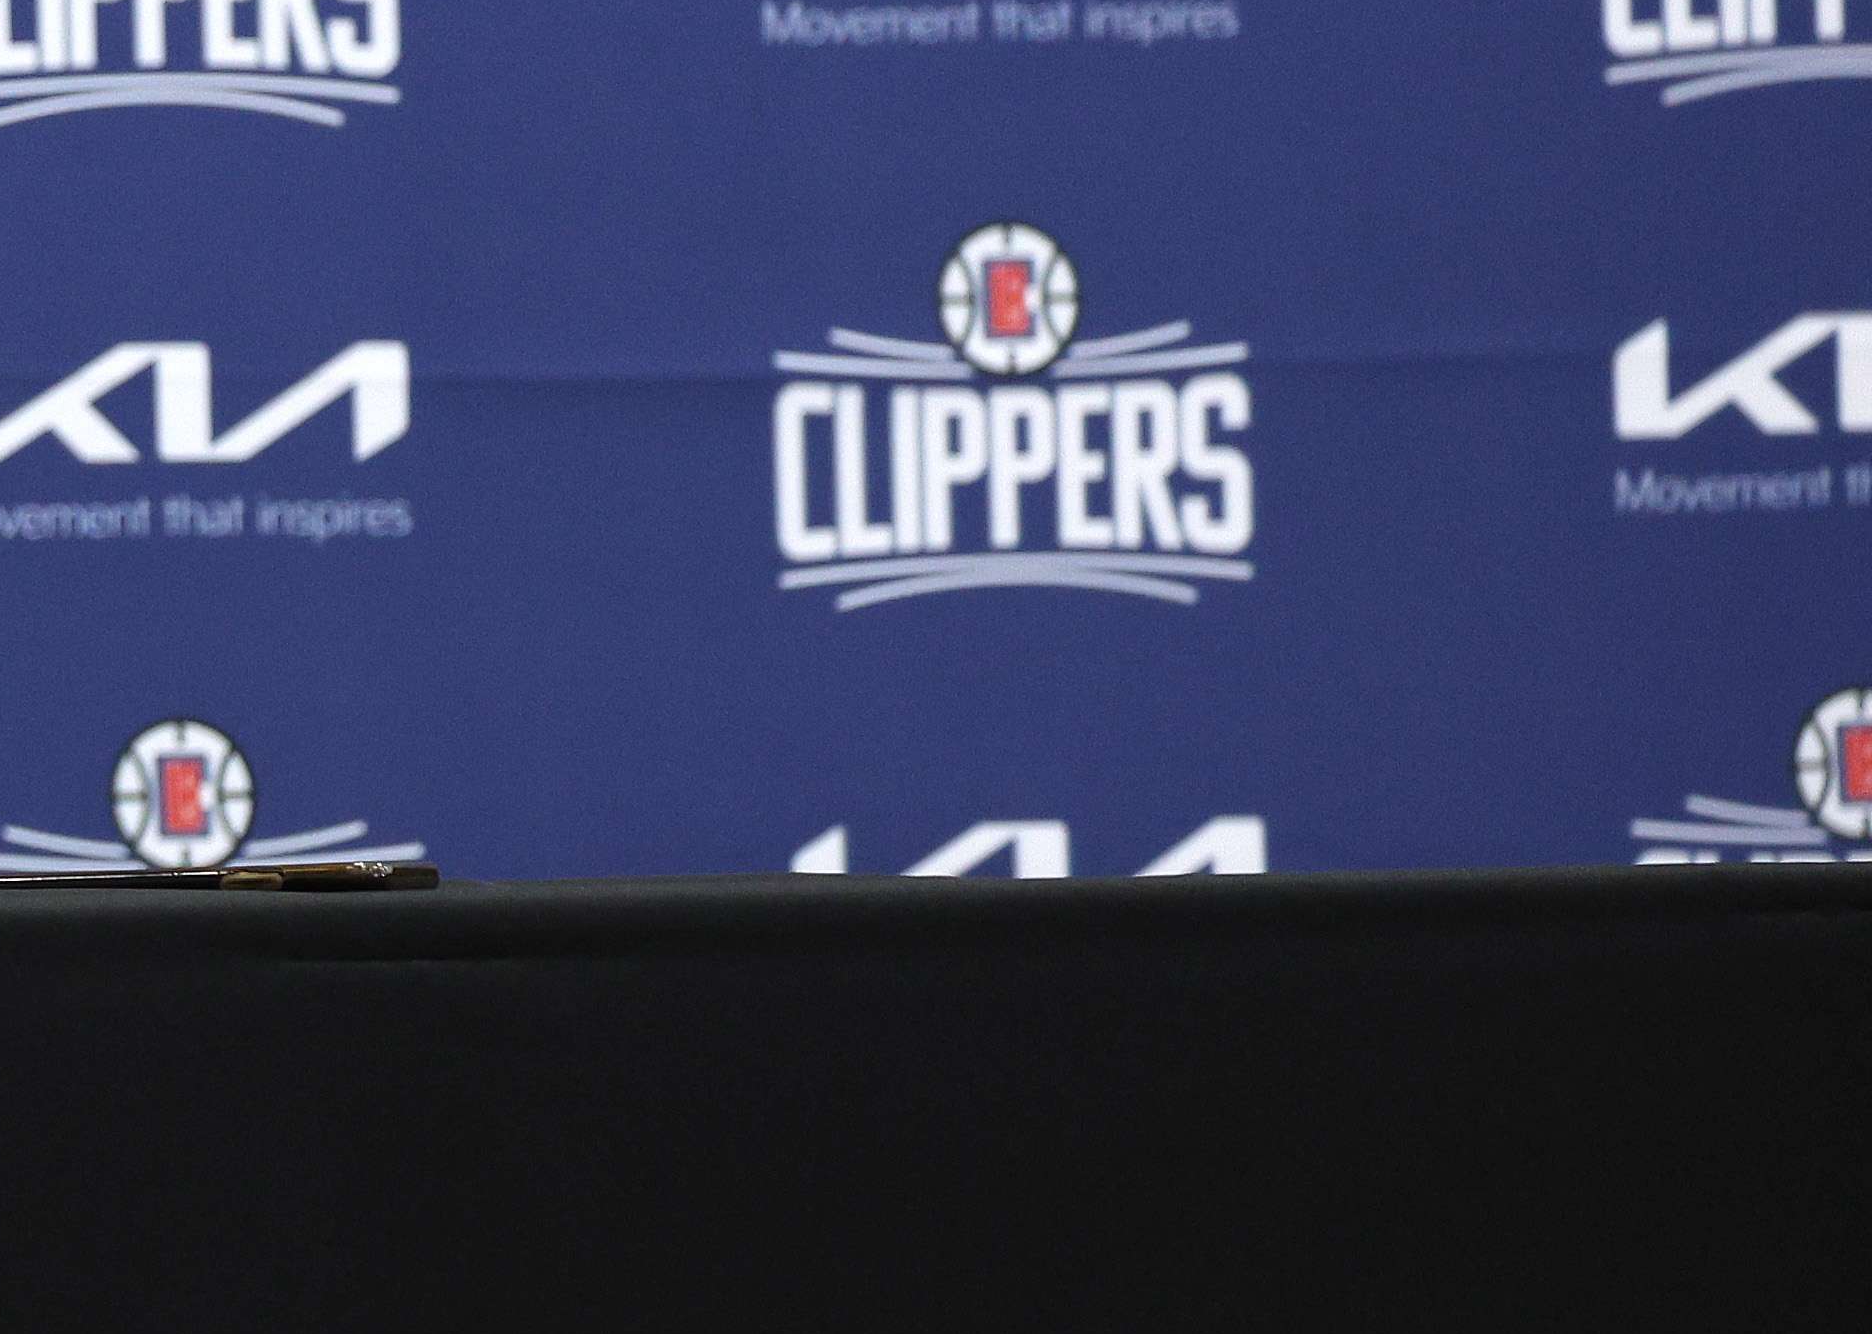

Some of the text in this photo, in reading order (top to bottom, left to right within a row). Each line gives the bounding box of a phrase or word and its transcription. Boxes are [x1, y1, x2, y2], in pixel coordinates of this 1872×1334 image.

[760, 0, 981, 45] Movement
[1612, 311, 1872, 440] KI
[774, 374, 1254, 562] CLIPPERS
[1614, 467, 1832, 513] Movement
[162, 494, 245, 537] that
[256, 494, 413, 544] inspires
